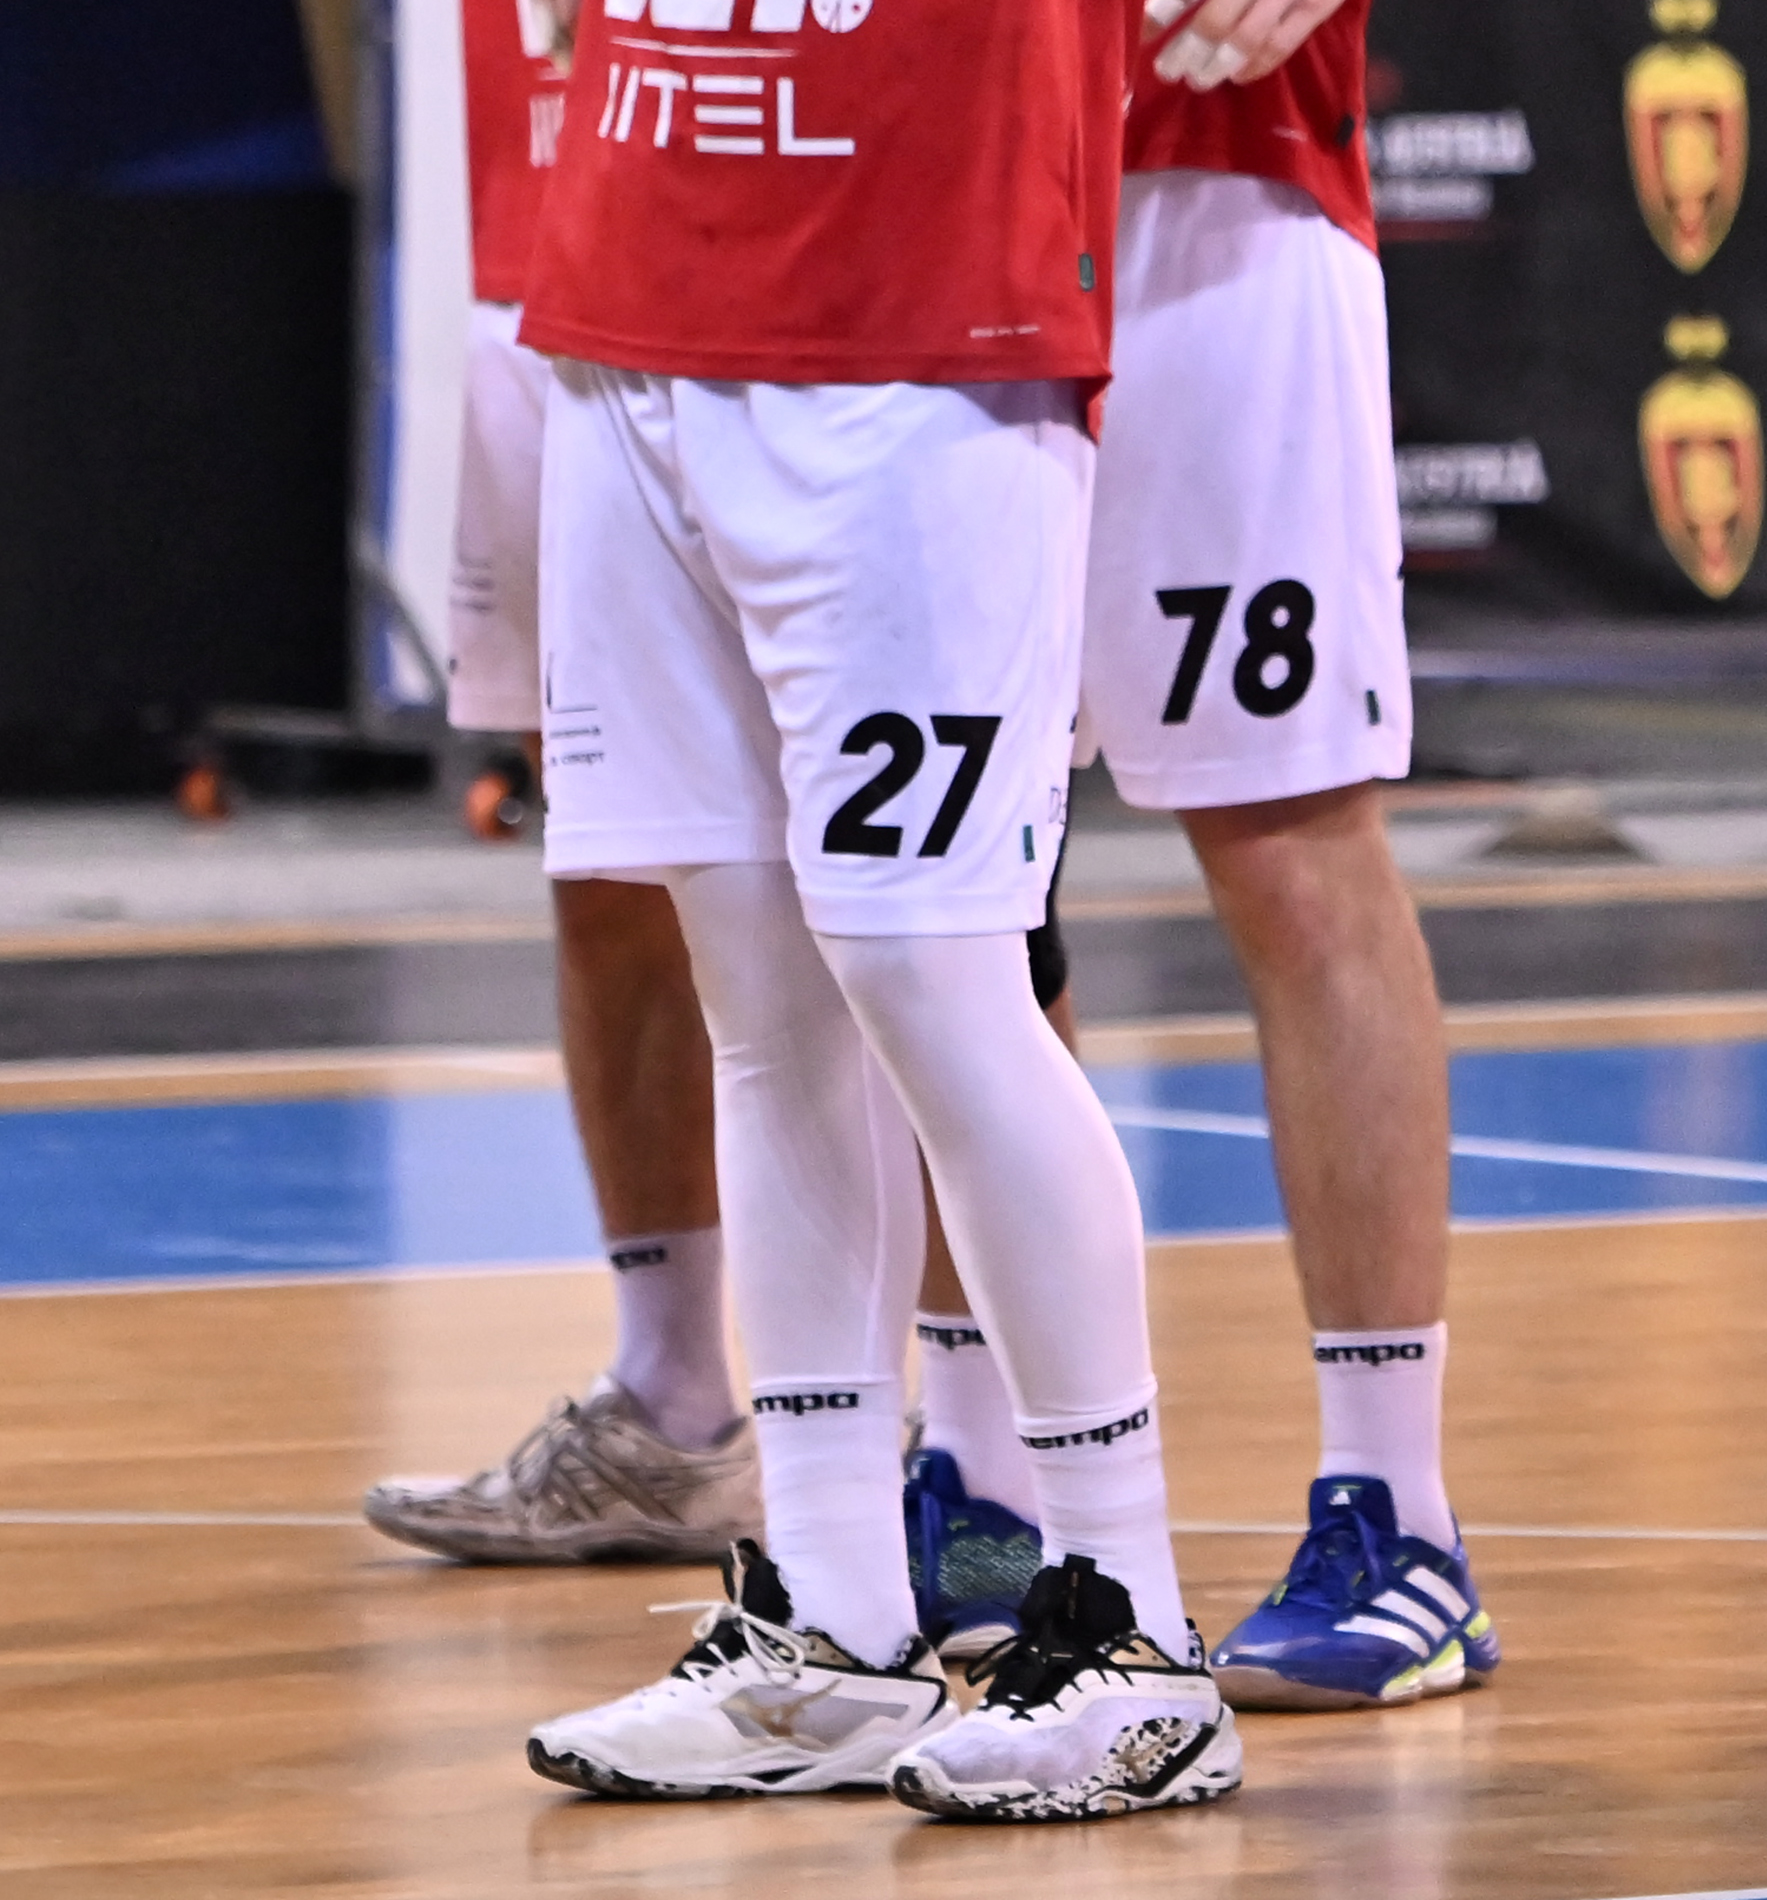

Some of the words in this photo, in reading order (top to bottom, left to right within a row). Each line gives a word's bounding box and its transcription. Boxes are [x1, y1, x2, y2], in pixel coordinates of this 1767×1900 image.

[1155, 578, 1316, 725] 78
[822, 711, 1003, 858] 27
[1314, 1342, 1425, 1367] empa
[752, 1392, 859, 1417] mpa
